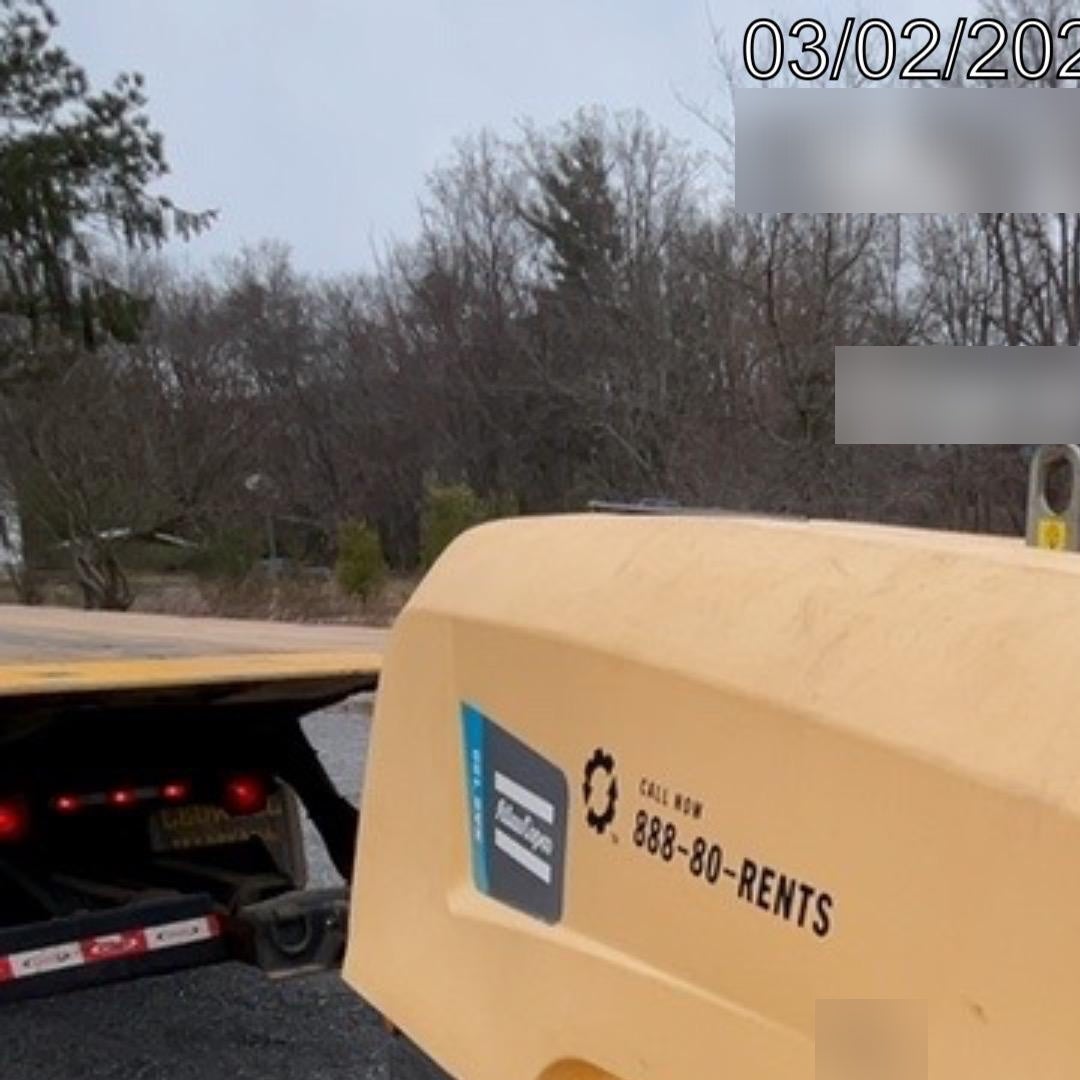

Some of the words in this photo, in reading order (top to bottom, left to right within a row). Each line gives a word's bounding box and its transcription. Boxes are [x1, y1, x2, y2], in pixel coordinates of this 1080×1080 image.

[639, 777, 669, 807] CALL
[674, 793, 703, 820] NOW
[632, 809, 834, 938] 888-80-RENTS
